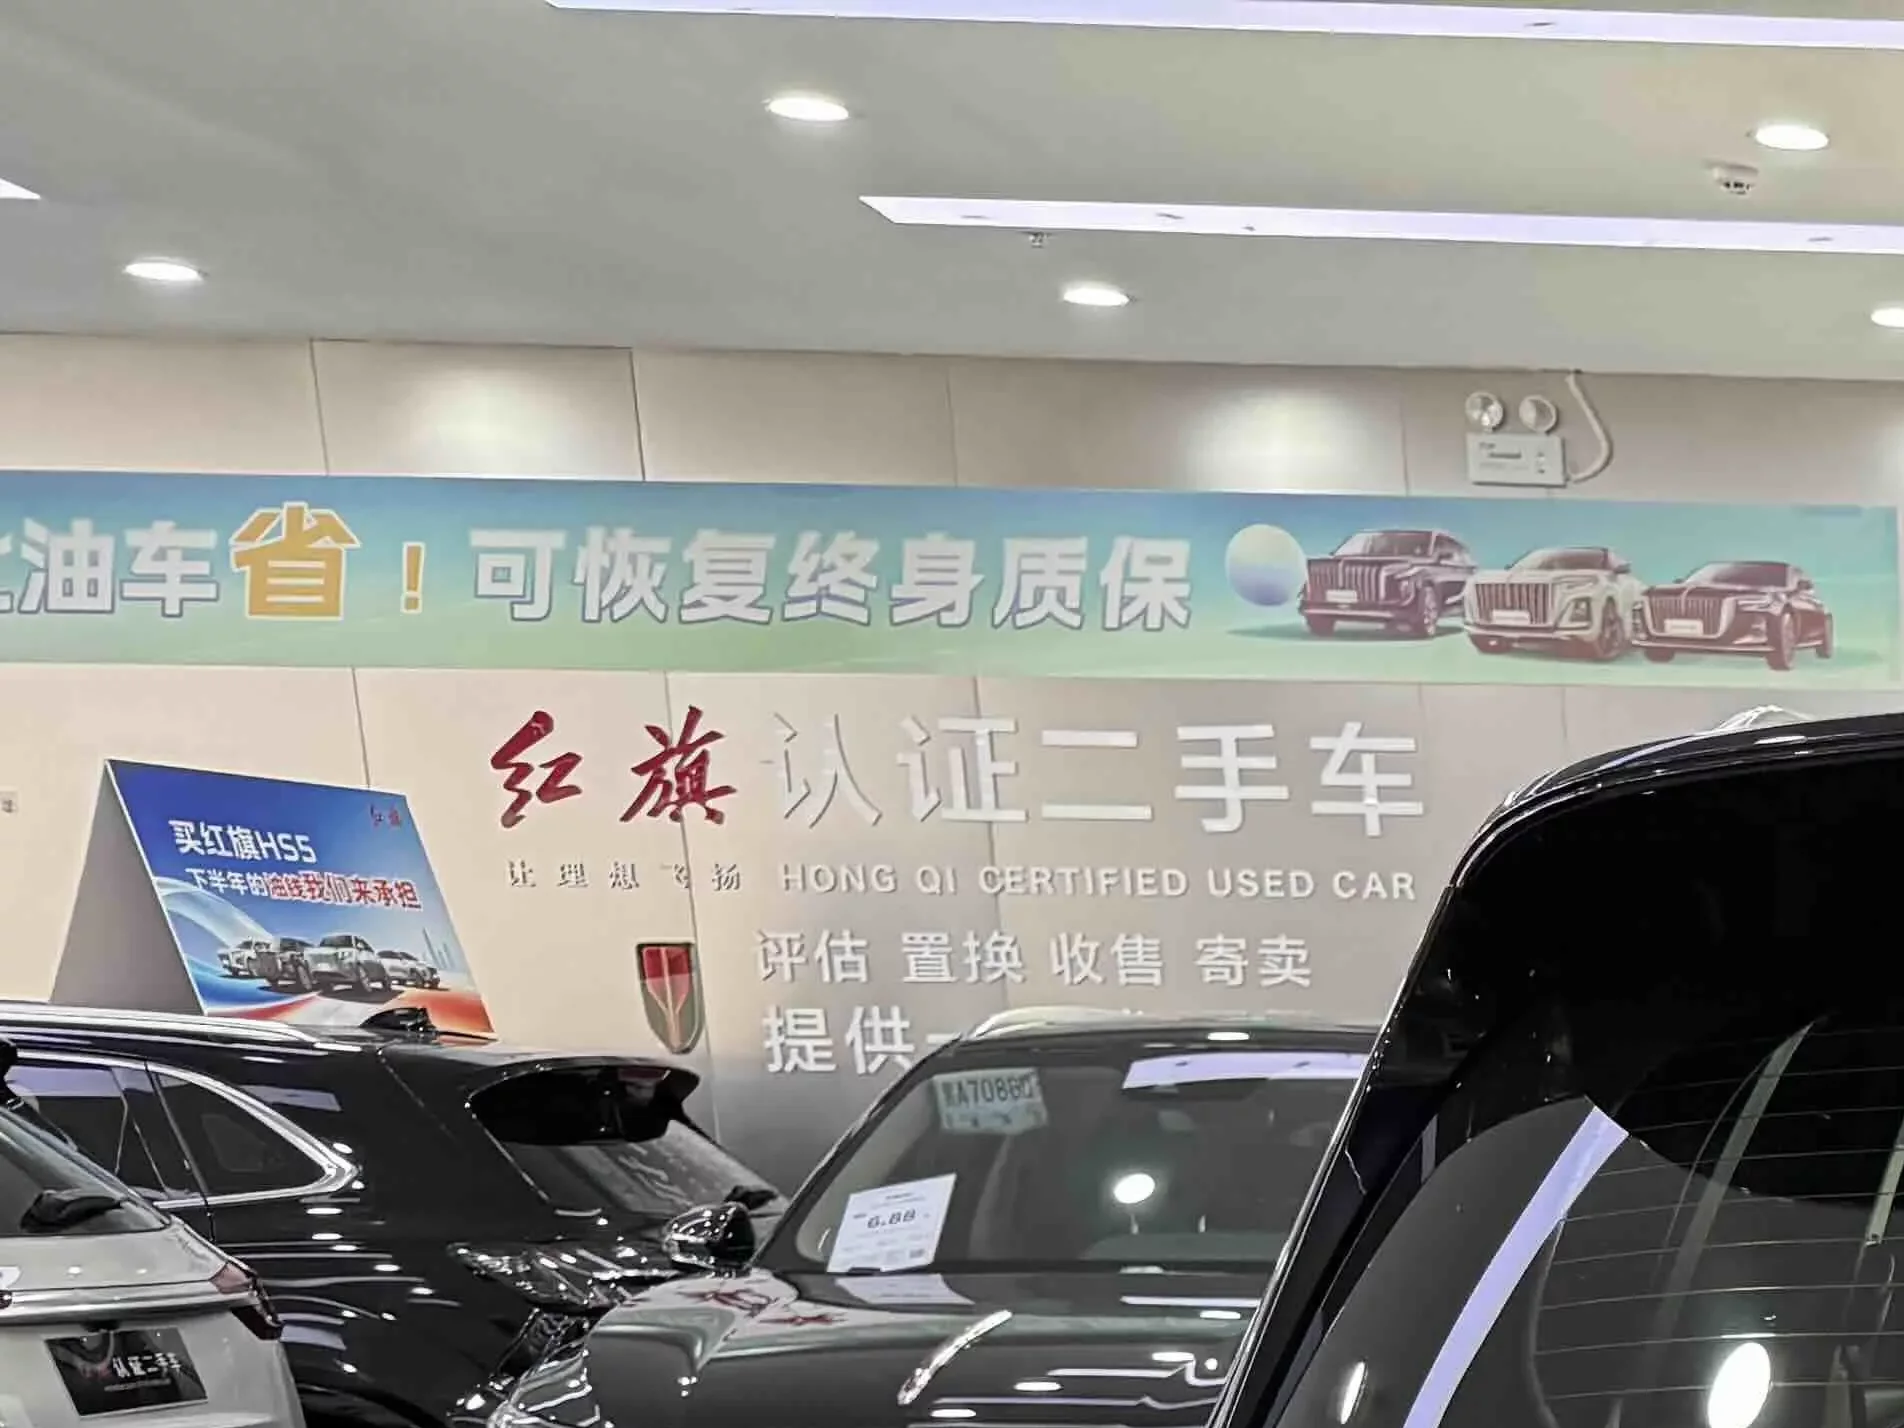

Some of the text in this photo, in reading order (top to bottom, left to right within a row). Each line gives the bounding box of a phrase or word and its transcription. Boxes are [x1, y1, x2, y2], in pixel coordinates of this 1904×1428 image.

[0, 501, 1193, 633] 油车省！可恢复终身质保
[782, 863, 1417, 901] HONG QI CERTIFIED USED CAR
[758, 928, 1313, 990] 评估 置换 收售 寄卖
